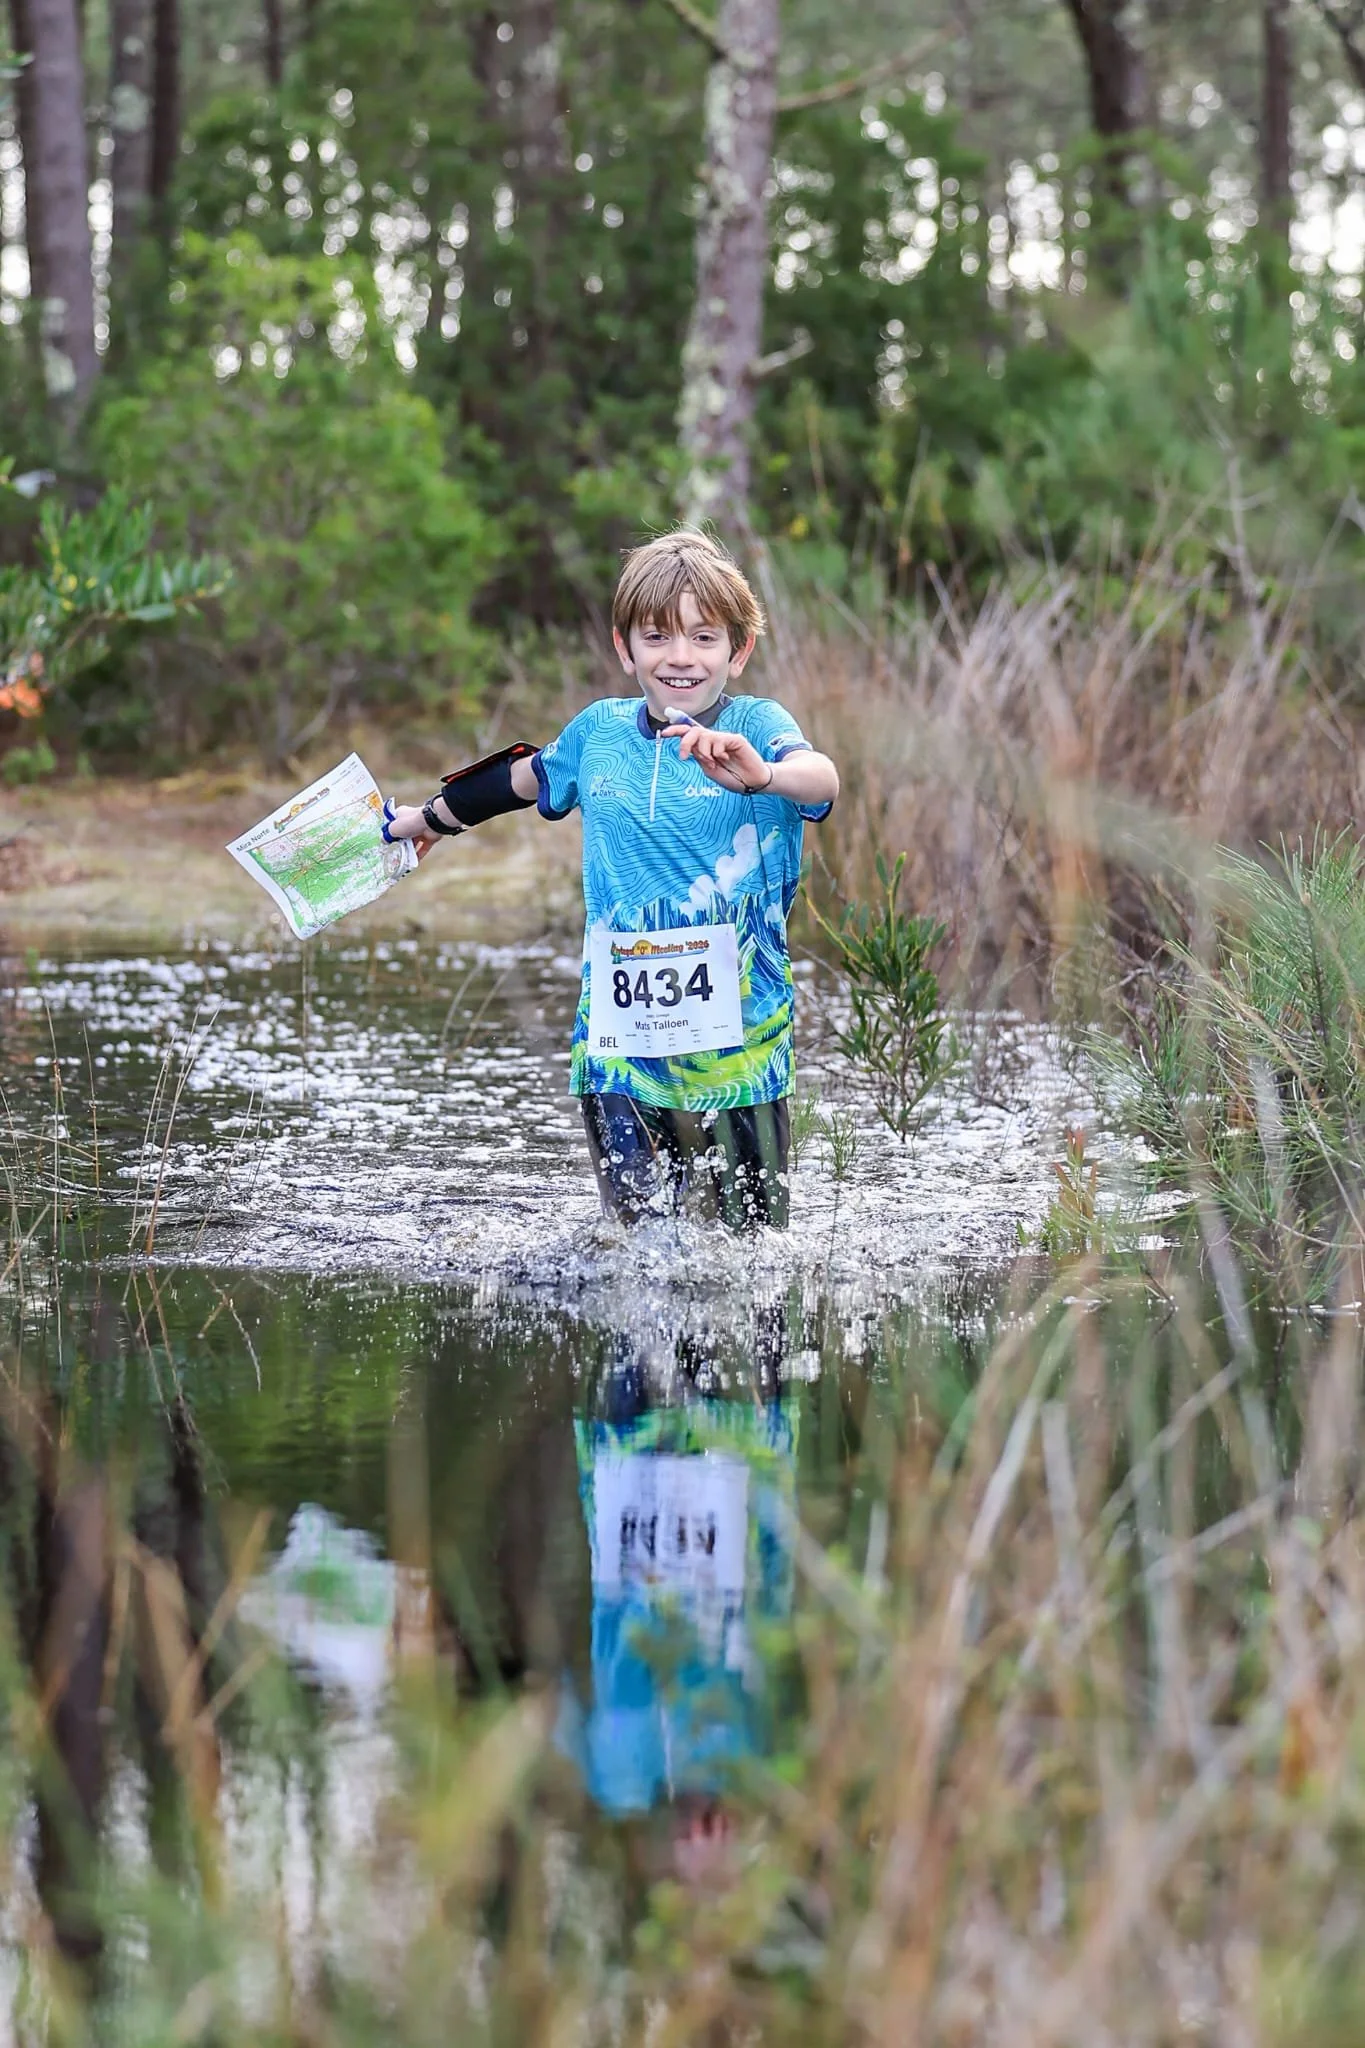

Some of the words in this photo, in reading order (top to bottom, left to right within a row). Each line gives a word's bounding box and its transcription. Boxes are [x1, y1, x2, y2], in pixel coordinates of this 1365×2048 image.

[251, 828, 270, 842] Norte
[651, 943, 684, 955] Meeting
[613, 963, 713, 1009] 8434
[635, 1020, 651, 1031] Mats
[652, 1019, 689, 1031] Talloen
[599, 1036, 619, 1048] BEL
